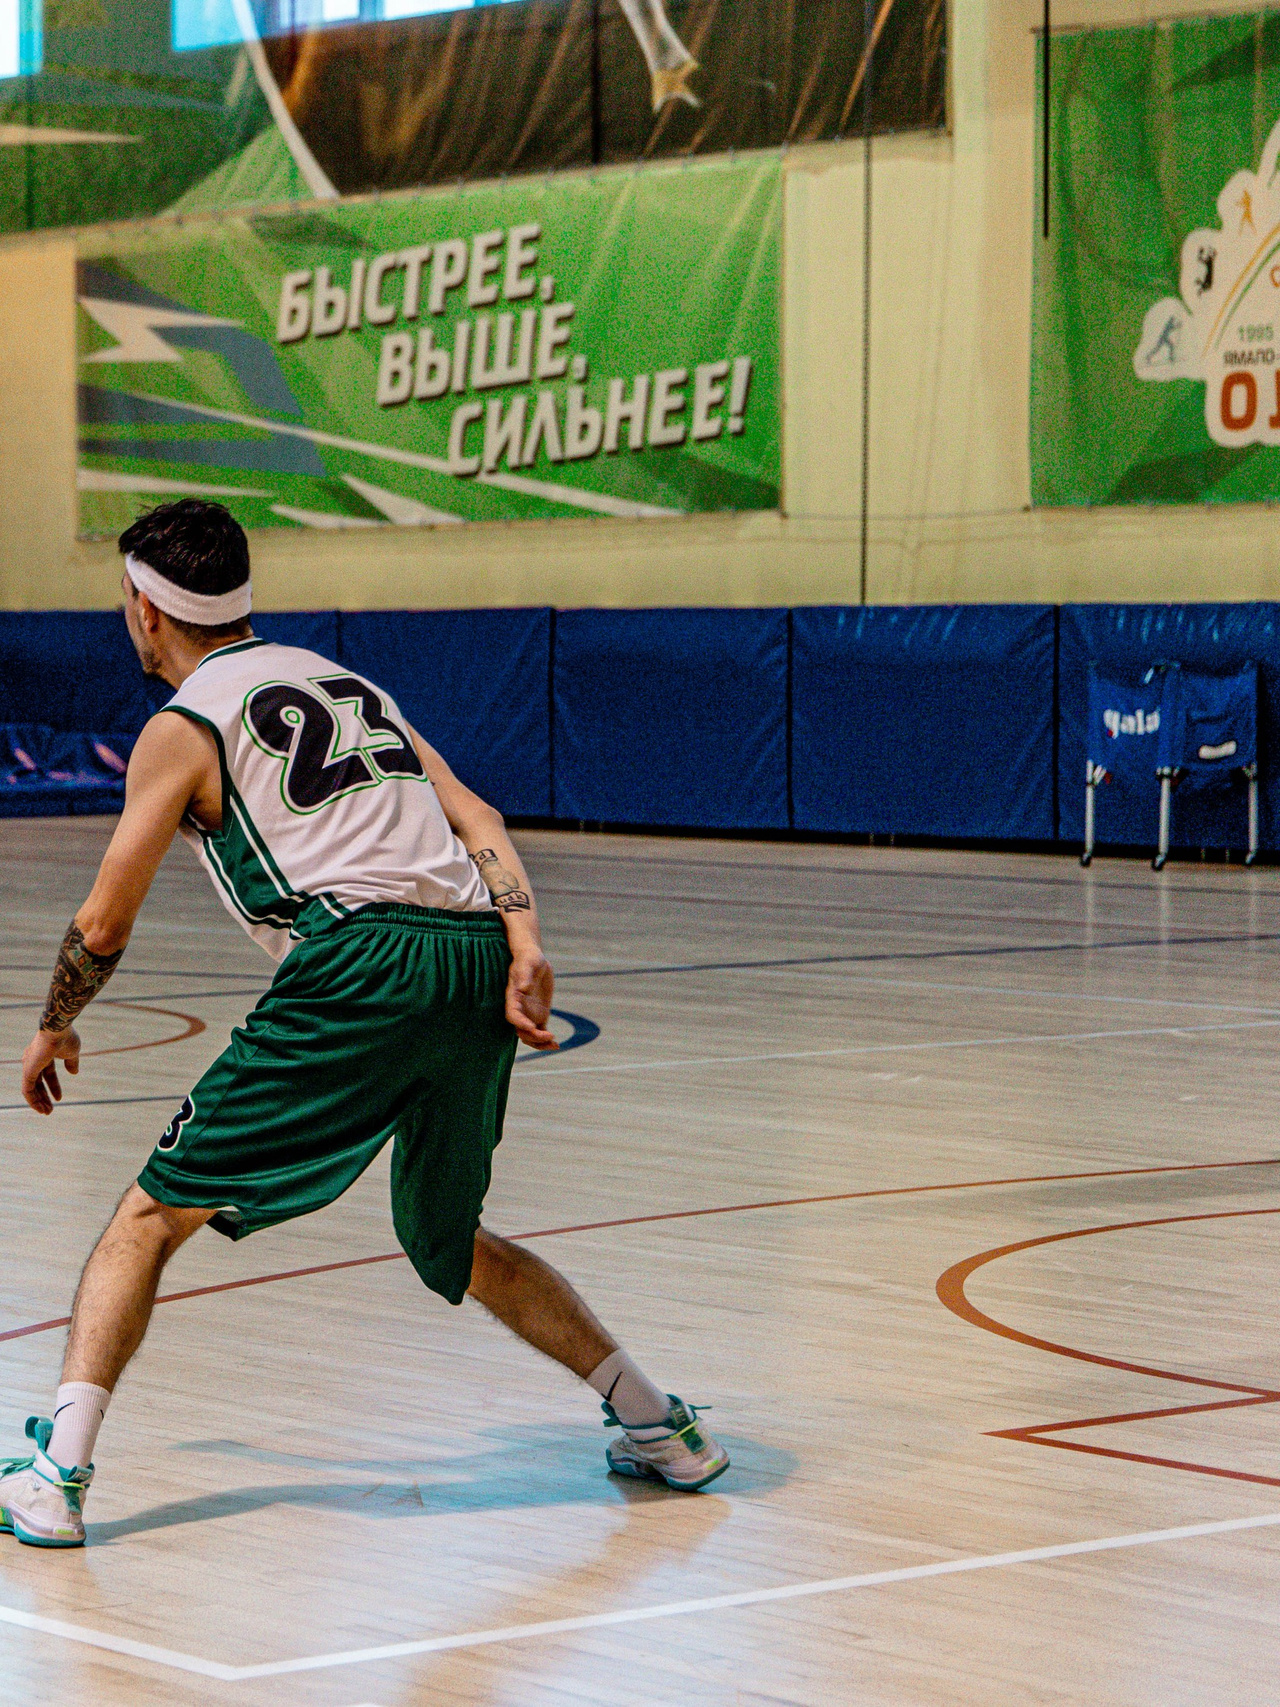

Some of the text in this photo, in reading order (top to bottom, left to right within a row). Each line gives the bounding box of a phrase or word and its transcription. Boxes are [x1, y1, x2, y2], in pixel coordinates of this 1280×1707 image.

[277, 223, 555, 344] БЫСТРЕЕ,
[376, 302, 587, 407] ВЫШЕ,
[446, 356, 753, 478] СИЛЬНЕЕ!
[243, 673, 429, 816] 23
